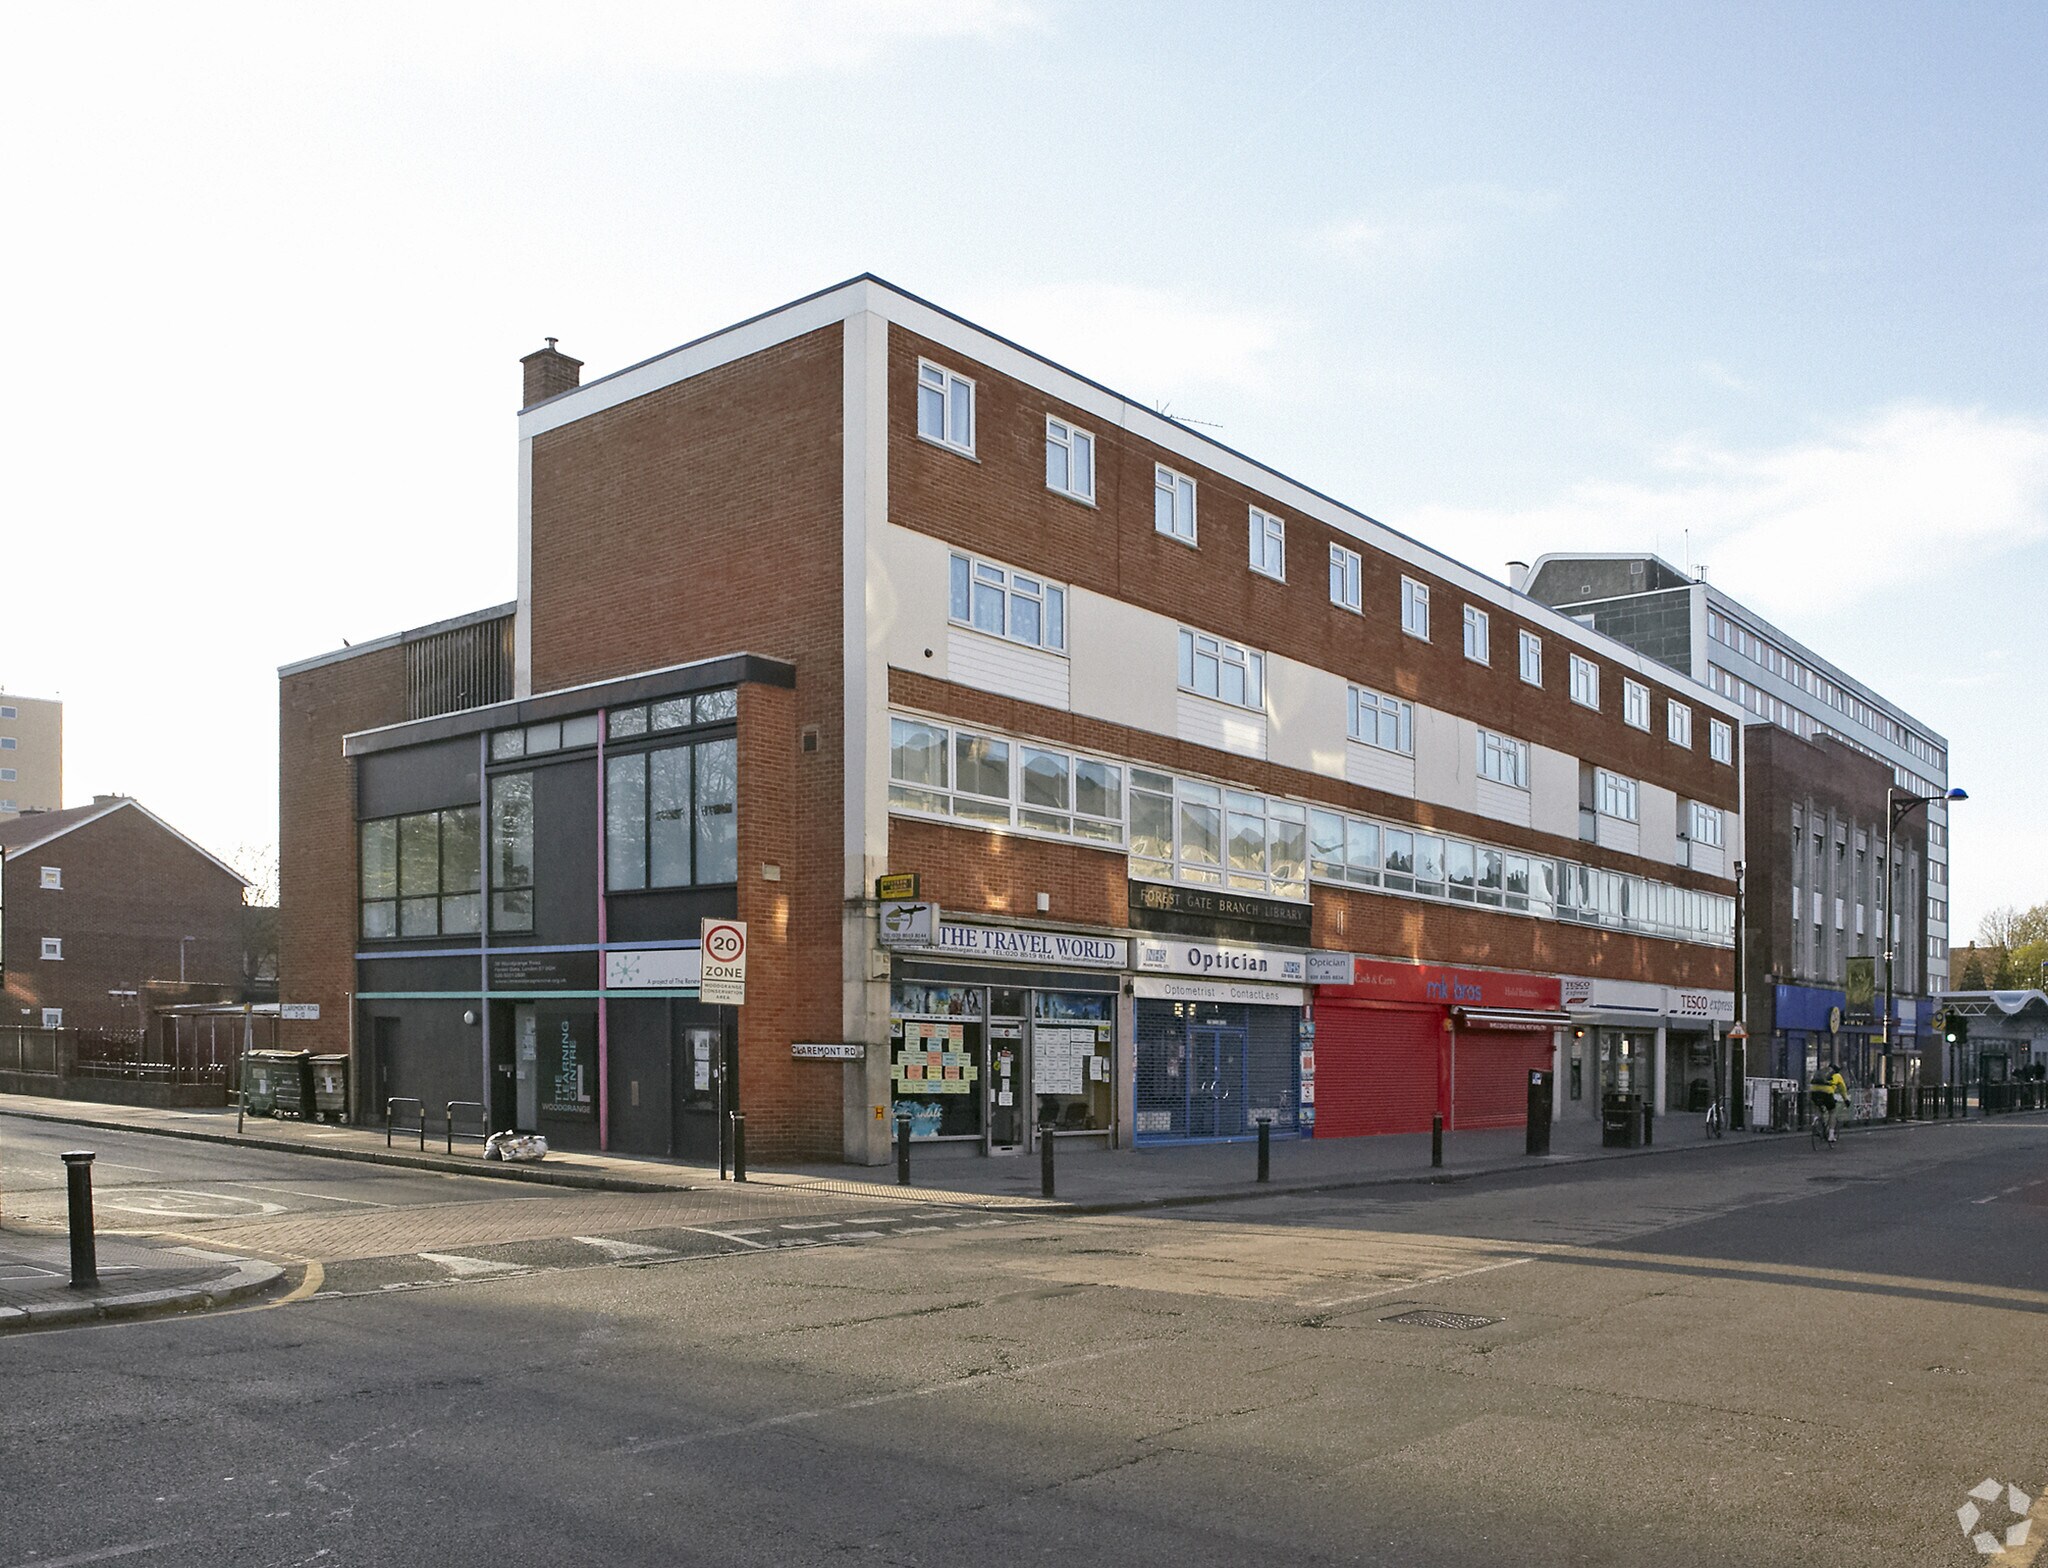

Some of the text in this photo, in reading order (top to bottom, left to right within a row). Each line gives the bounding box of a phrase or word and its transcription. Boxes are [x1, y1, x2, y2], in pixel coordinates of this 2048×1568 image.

[1140, 888, 1303, 921] FOREST GATE BRANCH LIBRARY
[713, 936, 737, 951] 20
[939, 926, 1116, 960] THE TRAVEL WORLD
[1019, 951, 1037, 959] 8519
[1038, 953, 1055, 961] 8144
[1146, 949, 1167, 962] NHS
[1187, 948, 1268, 972] Optician
[1309, 957, 1346, 968] Optician
[705, 966, 743, 978] ZONE
[1284, 962, 1301, 973] NHS
[1371, 975, 1377, 984] &
[1164, 984, 1216, 998] Optometrist
[1454, 976, 1482, 1001] bros
[1681, 994, 1734, 1014] TESCO express
[791, 1046, 856, 1056] CLAREMONT RD
[561, 1020, 570, 1101] LEARNING
[569, 1040, 577, 1102] CENTRE
[541, 1102, 591, 1114] WOODGRANGE
